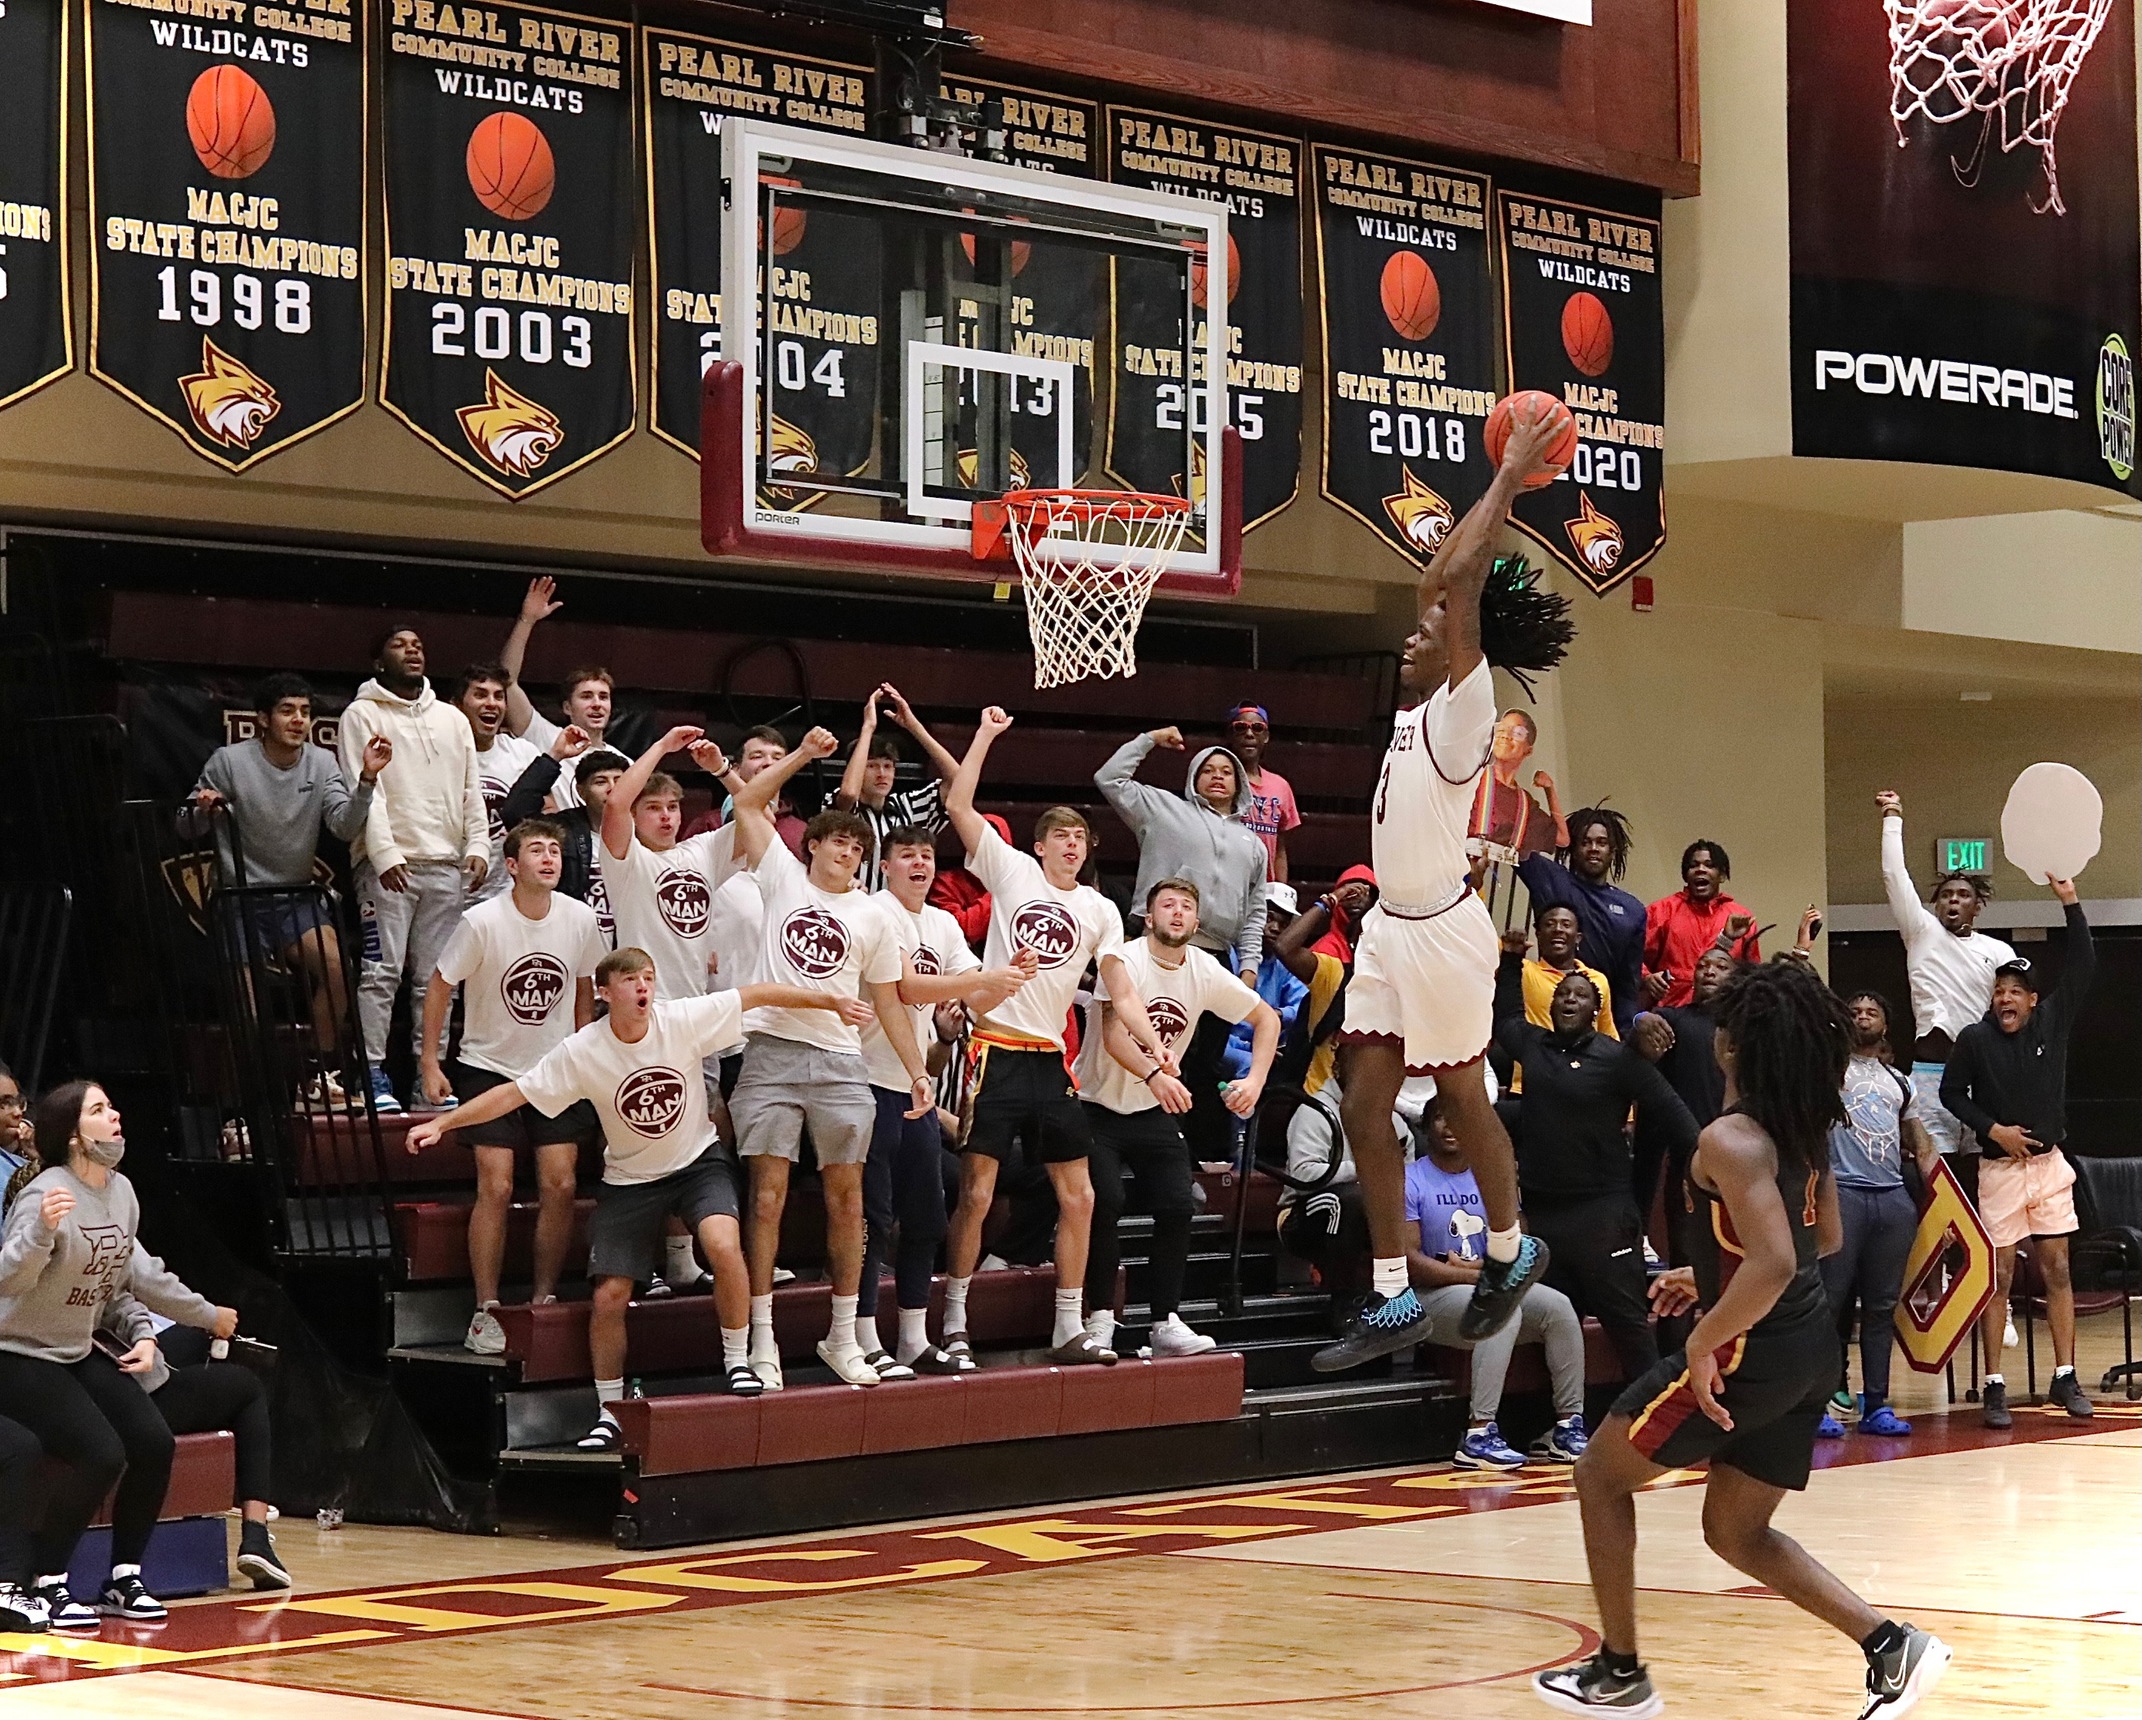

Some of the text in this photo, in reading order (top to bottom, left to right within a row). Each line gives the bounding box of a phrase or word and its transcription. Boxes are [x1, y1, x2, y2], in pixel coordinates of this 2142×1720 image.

[150, 19, 308, 67] WILDCATS
[254, 6, 351, 42] COLLEGE
[392, 0, 620, 63] PEARL RIVER
[392, 32, 620, 89] COMMUNITY COLLEGE
[659, 43, 864, 107] PEARL RIVER
[435, 68, 583, 113] WILDCATS
[660, 77, 865, 131] COMMUNITY COLLEGE
[1002, 97, 1086, 138] RIVER
[1013, 131, 1087, 162] COLLEGE
[1120, 118, 1292, 174] PEARL RIVER
[1121, 150, 1294, 196] COMMUNITY COLLEGE
[1324, 156, 1482, 208] PEARL RIVER
[187, 186, 279, 230] MACJC
[1327, 186, 1484, 230] COMMUNITY COLLEGE
[1508, 202, 1653, 253] PEARL RIVER
[106, 217, 358, 279] STATE CHAMPIONS
[465, 228, 559, 268] MACJC
[1356, 215, 1457, 251] WILDCATS
[1511, 230, 1655, 274] COMMUNITY COLLEGE
[391, 257, 631, 314] STATE CHAMPIONS
[1538, 258, 1631, 293] WILDCATS
[157, 266, 311, 334] 1998
[432, 302, 592, 368] 2003
[1125, 344, 1182, 378] STATE
[1382, 347, 1447, 381] MACJC
[1337, 371, 1496, 417] STATE CHAMPIONS
[1563, 381, 1618, 414] MACJC
[1816, 350, 2075, 419] POWERADE
[2101, 346, 2132, 423] CORE
[1369, 410, 1465, 463] 2018
[1574, 412, 1664, 449] CHAMPIONS
[1553, 443, 1642, 491] 020
[1948, 841, 1985, 870] EXIT
[663, 899, 707, 918] MAN
[673, 884, 698, 901] 6TH
[804, 925, 834, 940] 6TH
[1019, 922, 1068, 954] MAN
[1034, 917, 1064, 931] 6TH
[790, 929, 838, 962] MAN
[512, 987, 557, 1006] MAN
[524, 973, 551, 989] 6TH
[629, 1092, 680, 1122] MAN
[638, 1084, 666, 1106] 6TH
[1459, 1193, 1479, 1206] DO
